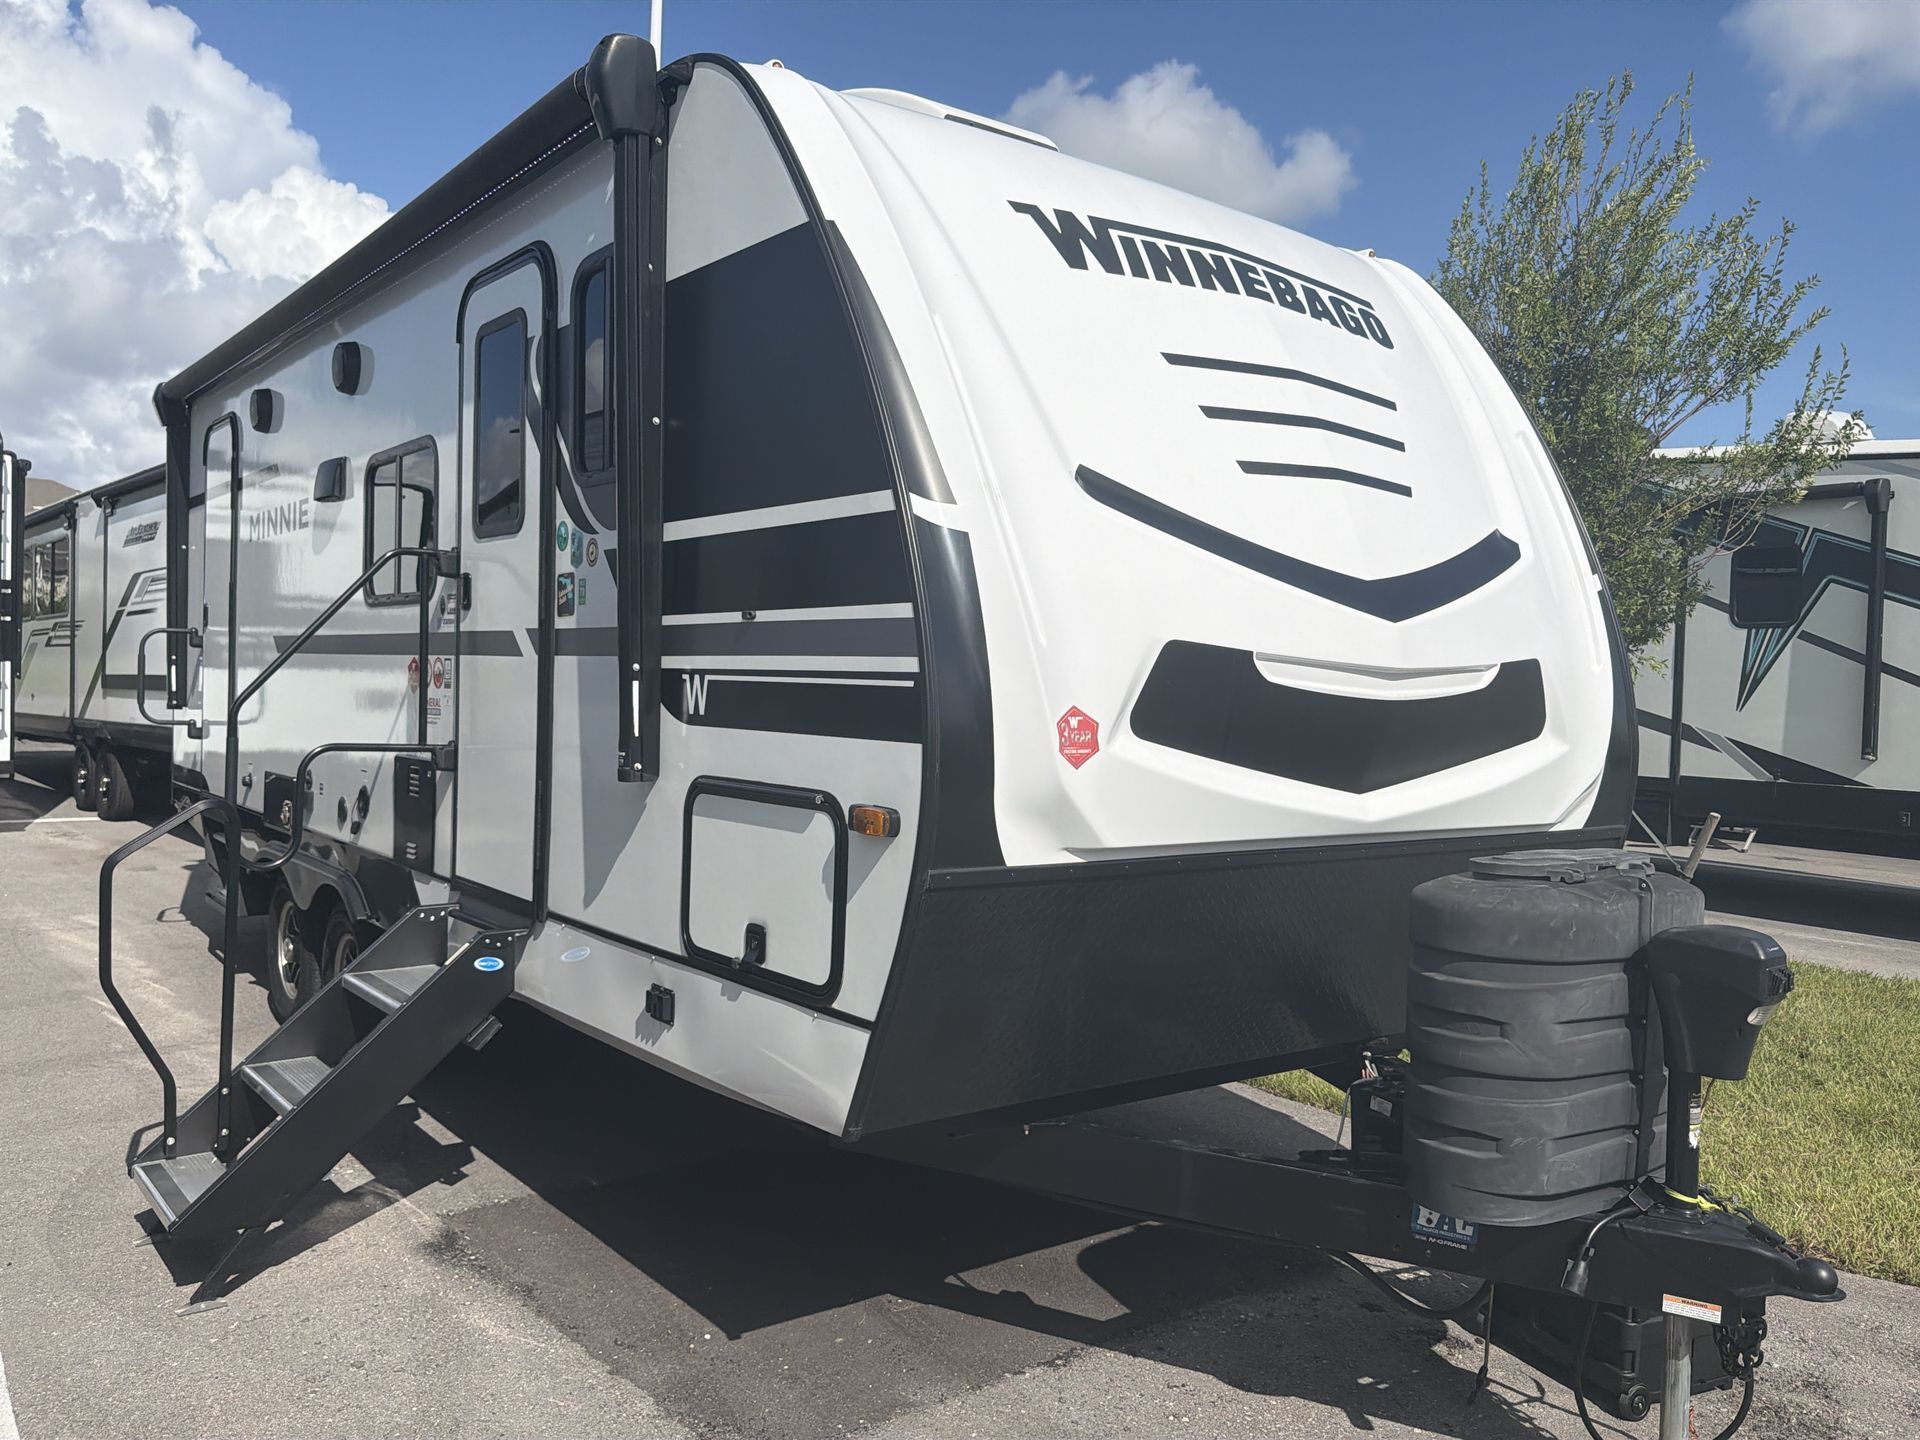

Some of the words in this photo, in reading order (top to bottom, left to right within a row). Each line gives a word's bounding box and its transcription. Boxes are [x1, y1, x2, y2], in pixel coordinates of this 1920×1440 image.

[1006, 199, 1394, 350] WINNEBAGO
[249, 497, 309, 543] MINNIE
[682, 674, 709, 715] W
[1681, 1299, 1708, 1309] WARNING
